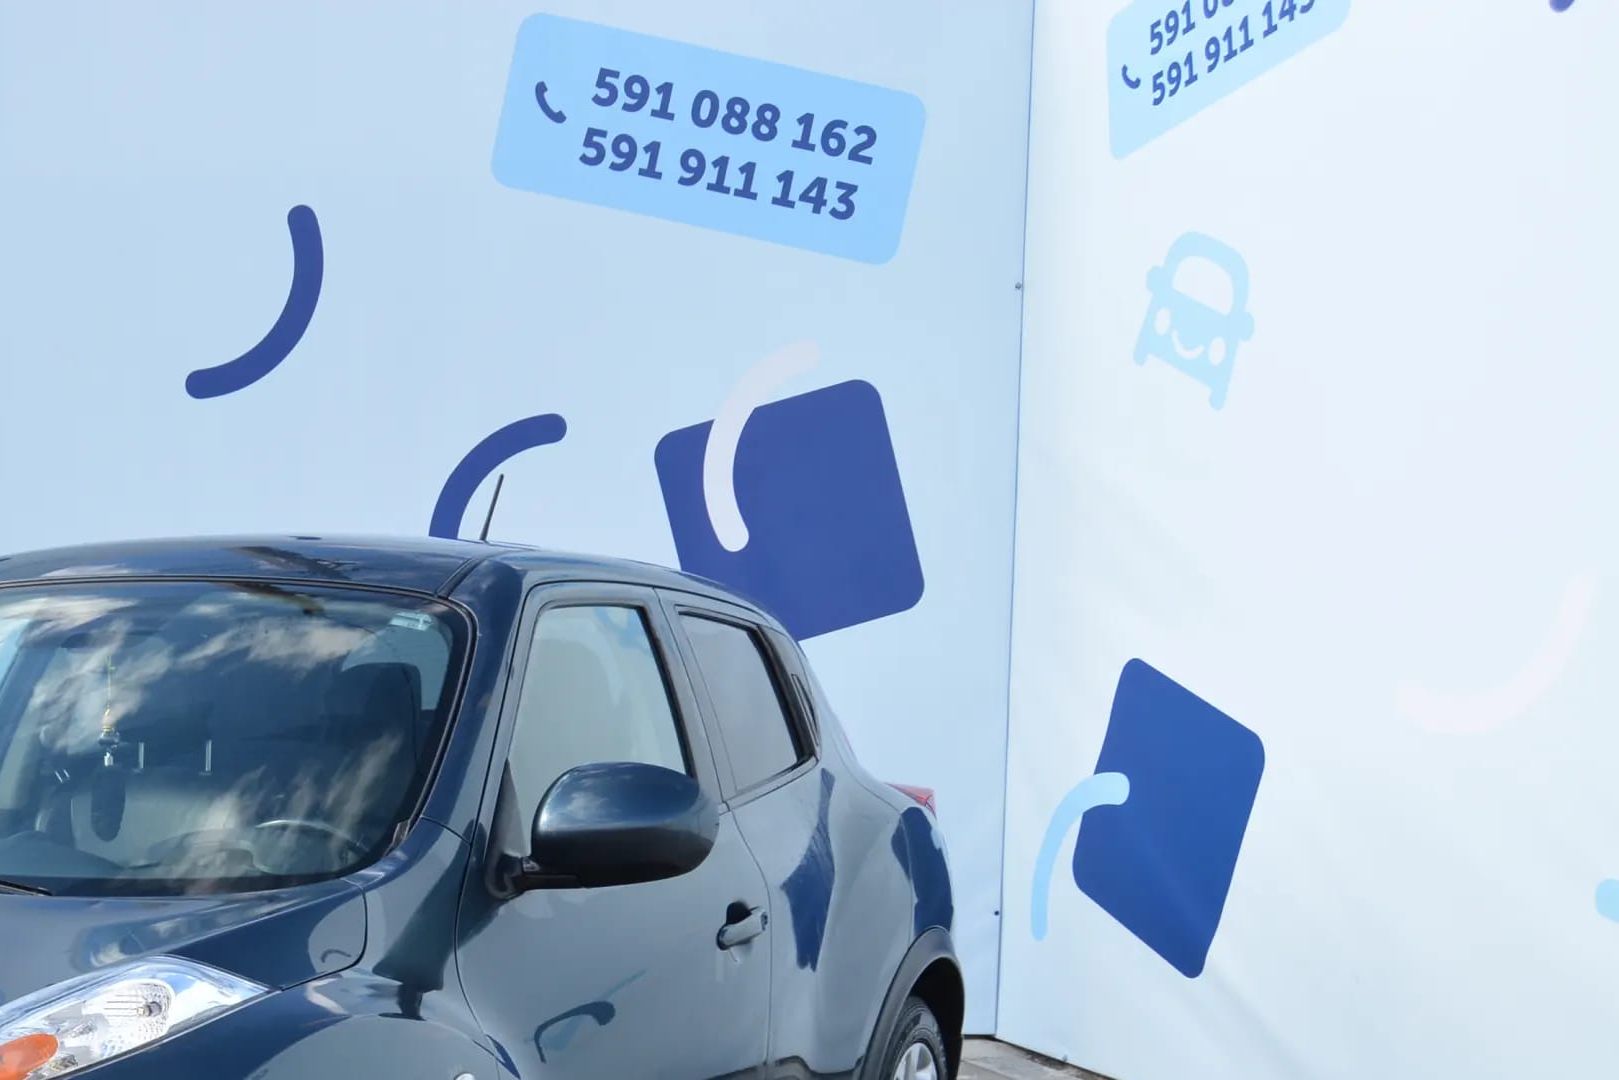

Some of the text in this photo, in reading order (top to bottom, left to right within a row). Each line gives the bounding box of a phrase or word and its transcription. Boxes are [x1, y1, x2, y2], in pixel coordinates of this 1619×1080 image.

[1150, 0, 1195, 55] 591
[1152, 51, 1197, 106] 591
[1205, 15, 1254, 73] 911
[591, 67, 877, 165] 591 088 162
[579, 127, 859, 220] 591 911 143
